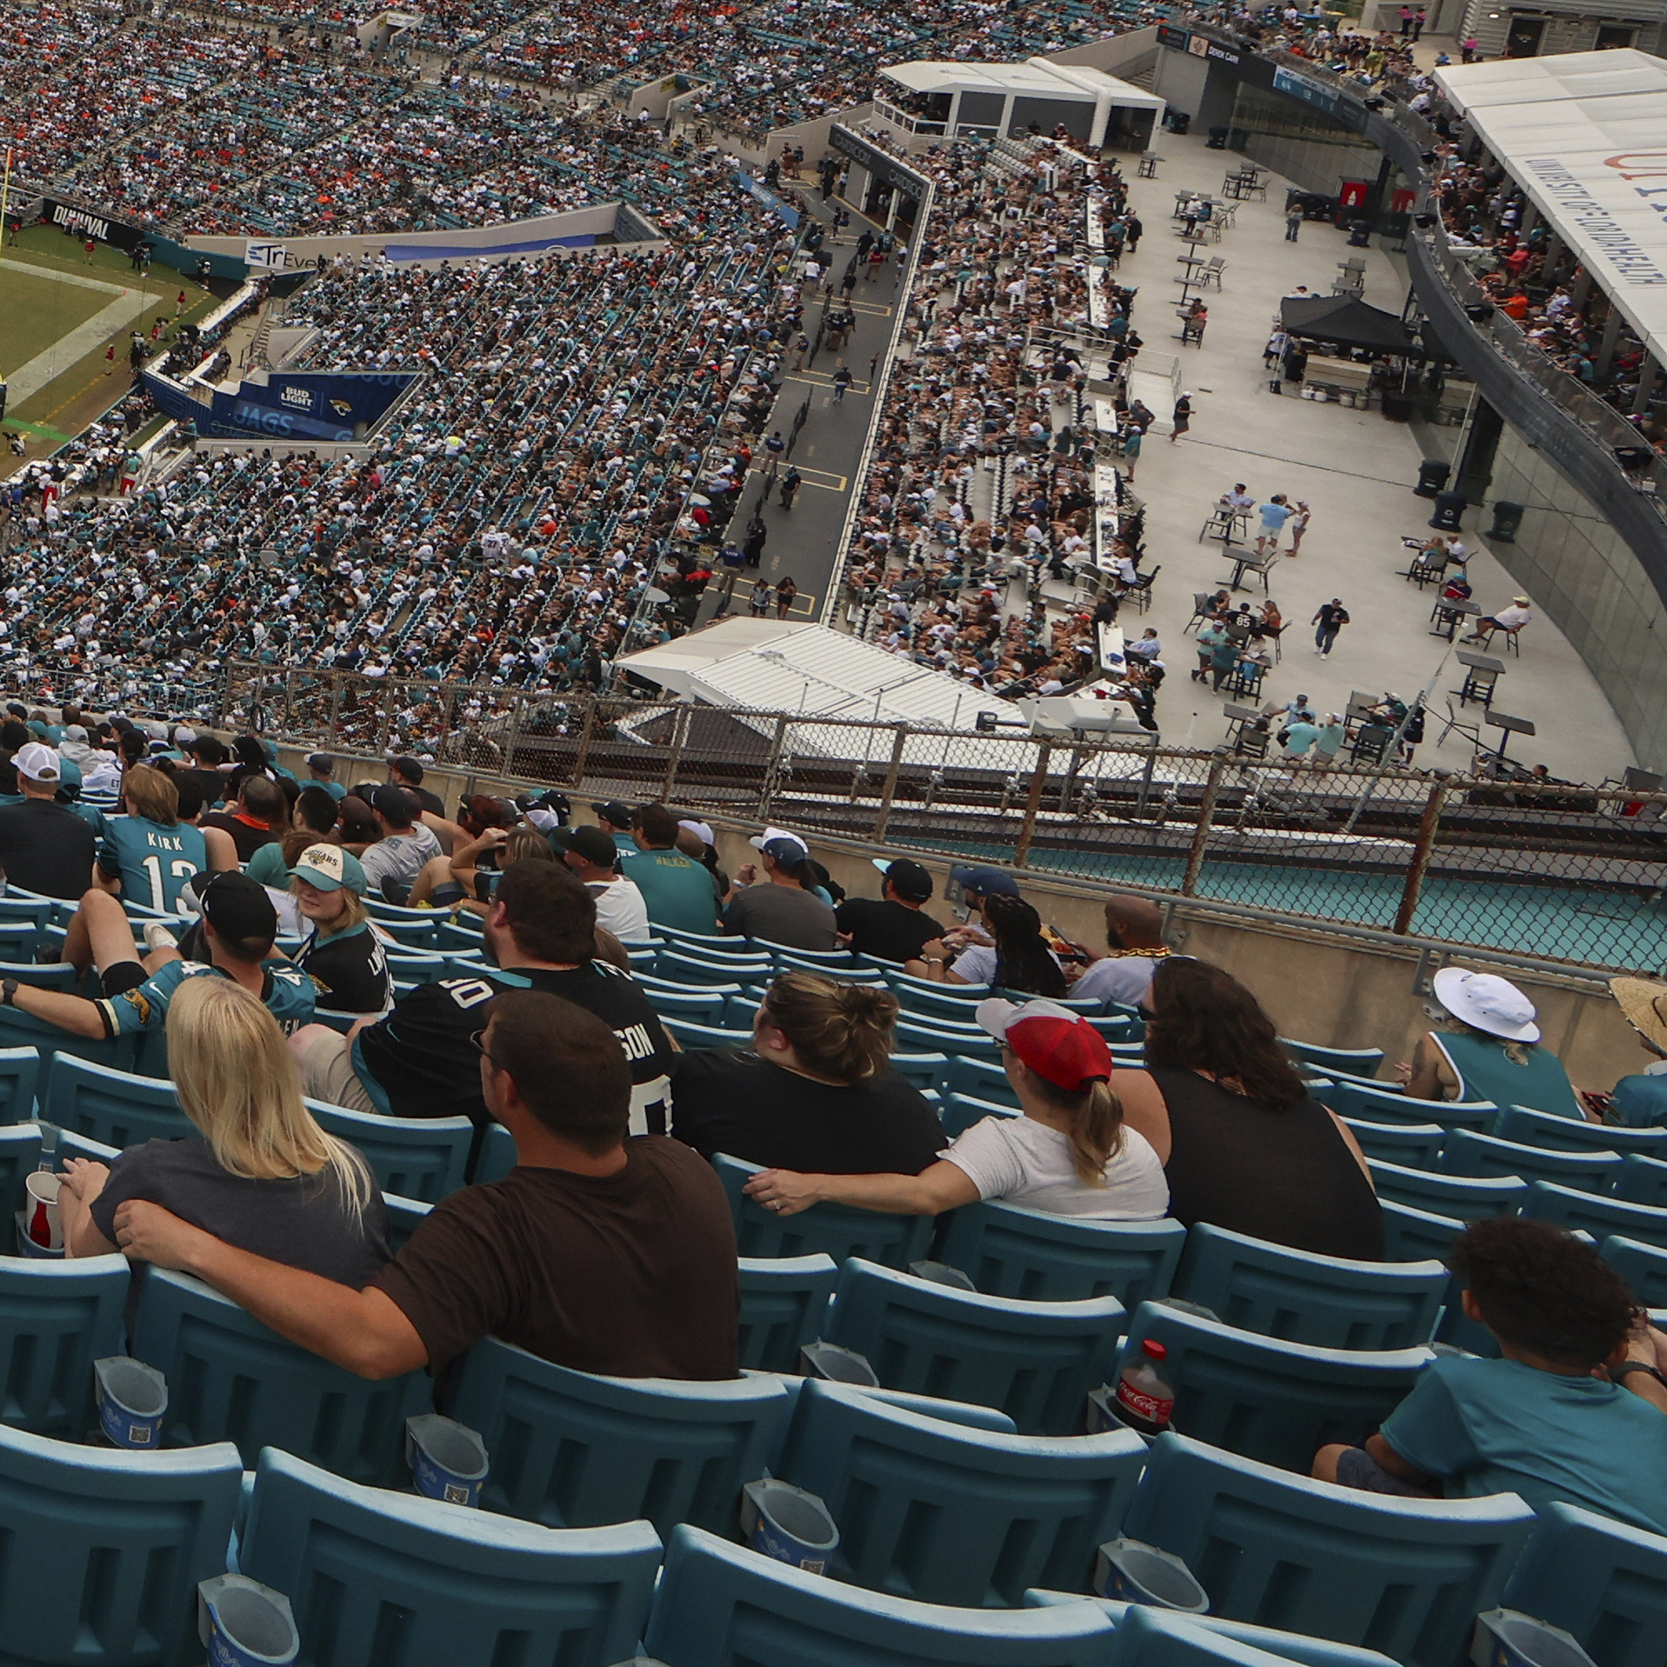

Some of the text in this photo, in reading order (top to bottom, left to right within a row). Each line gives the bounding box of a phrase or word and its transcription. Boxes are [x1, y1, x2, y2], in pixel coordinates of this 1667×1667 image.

[1524, 158, 1594, 200] UNIVERSITY
[280, 392, 314, 408] LIGHT
[285, 385, 309, 399] BUD
[233, 406, 295, 436] JAGS
[146, 830, 184, 851] KIRK
